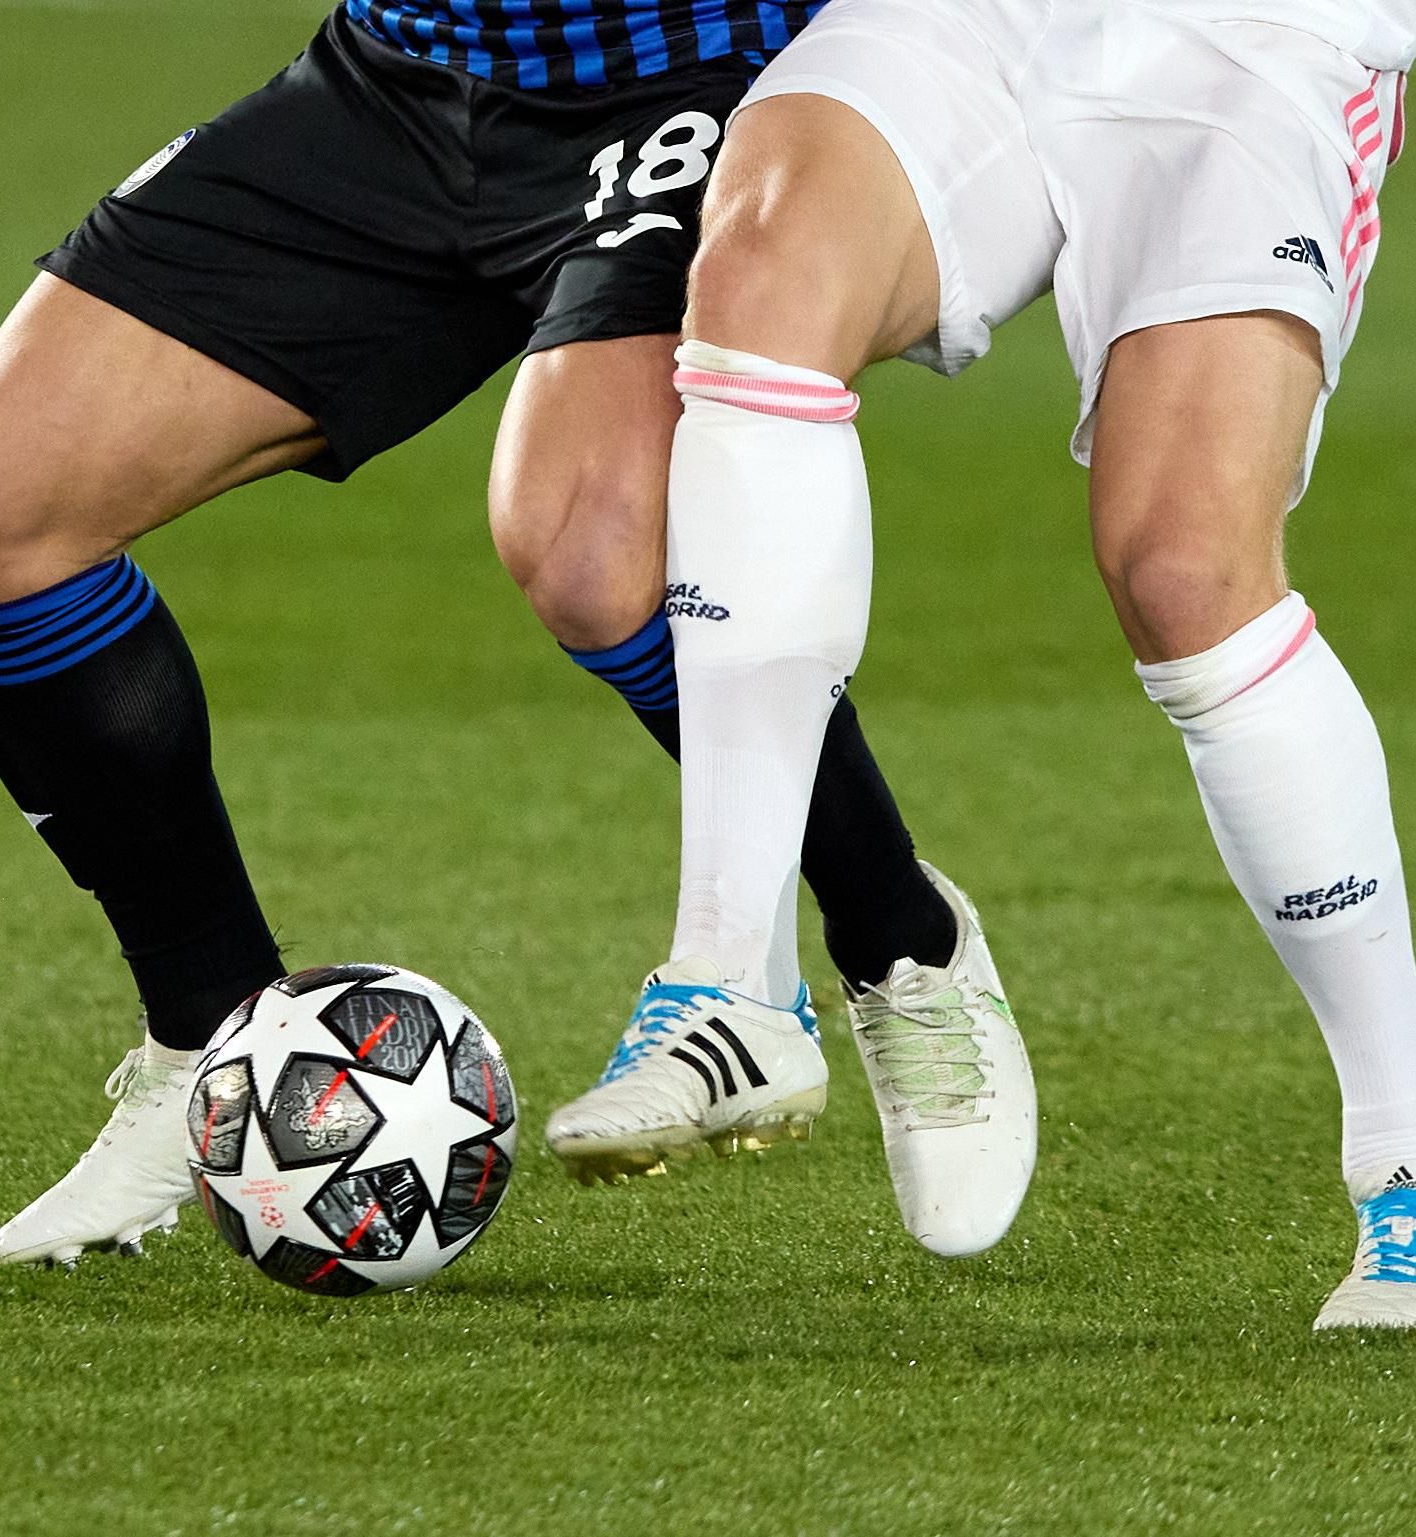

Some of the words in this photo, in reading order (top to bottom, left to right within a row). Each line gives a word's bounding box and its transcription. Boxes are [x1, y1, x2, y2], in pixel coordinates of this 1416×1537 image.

[583, 110, 721, 223] 18
[1274, 878, 1379, 922] MADRID
[1283, 874, 1361, 909] REAL
